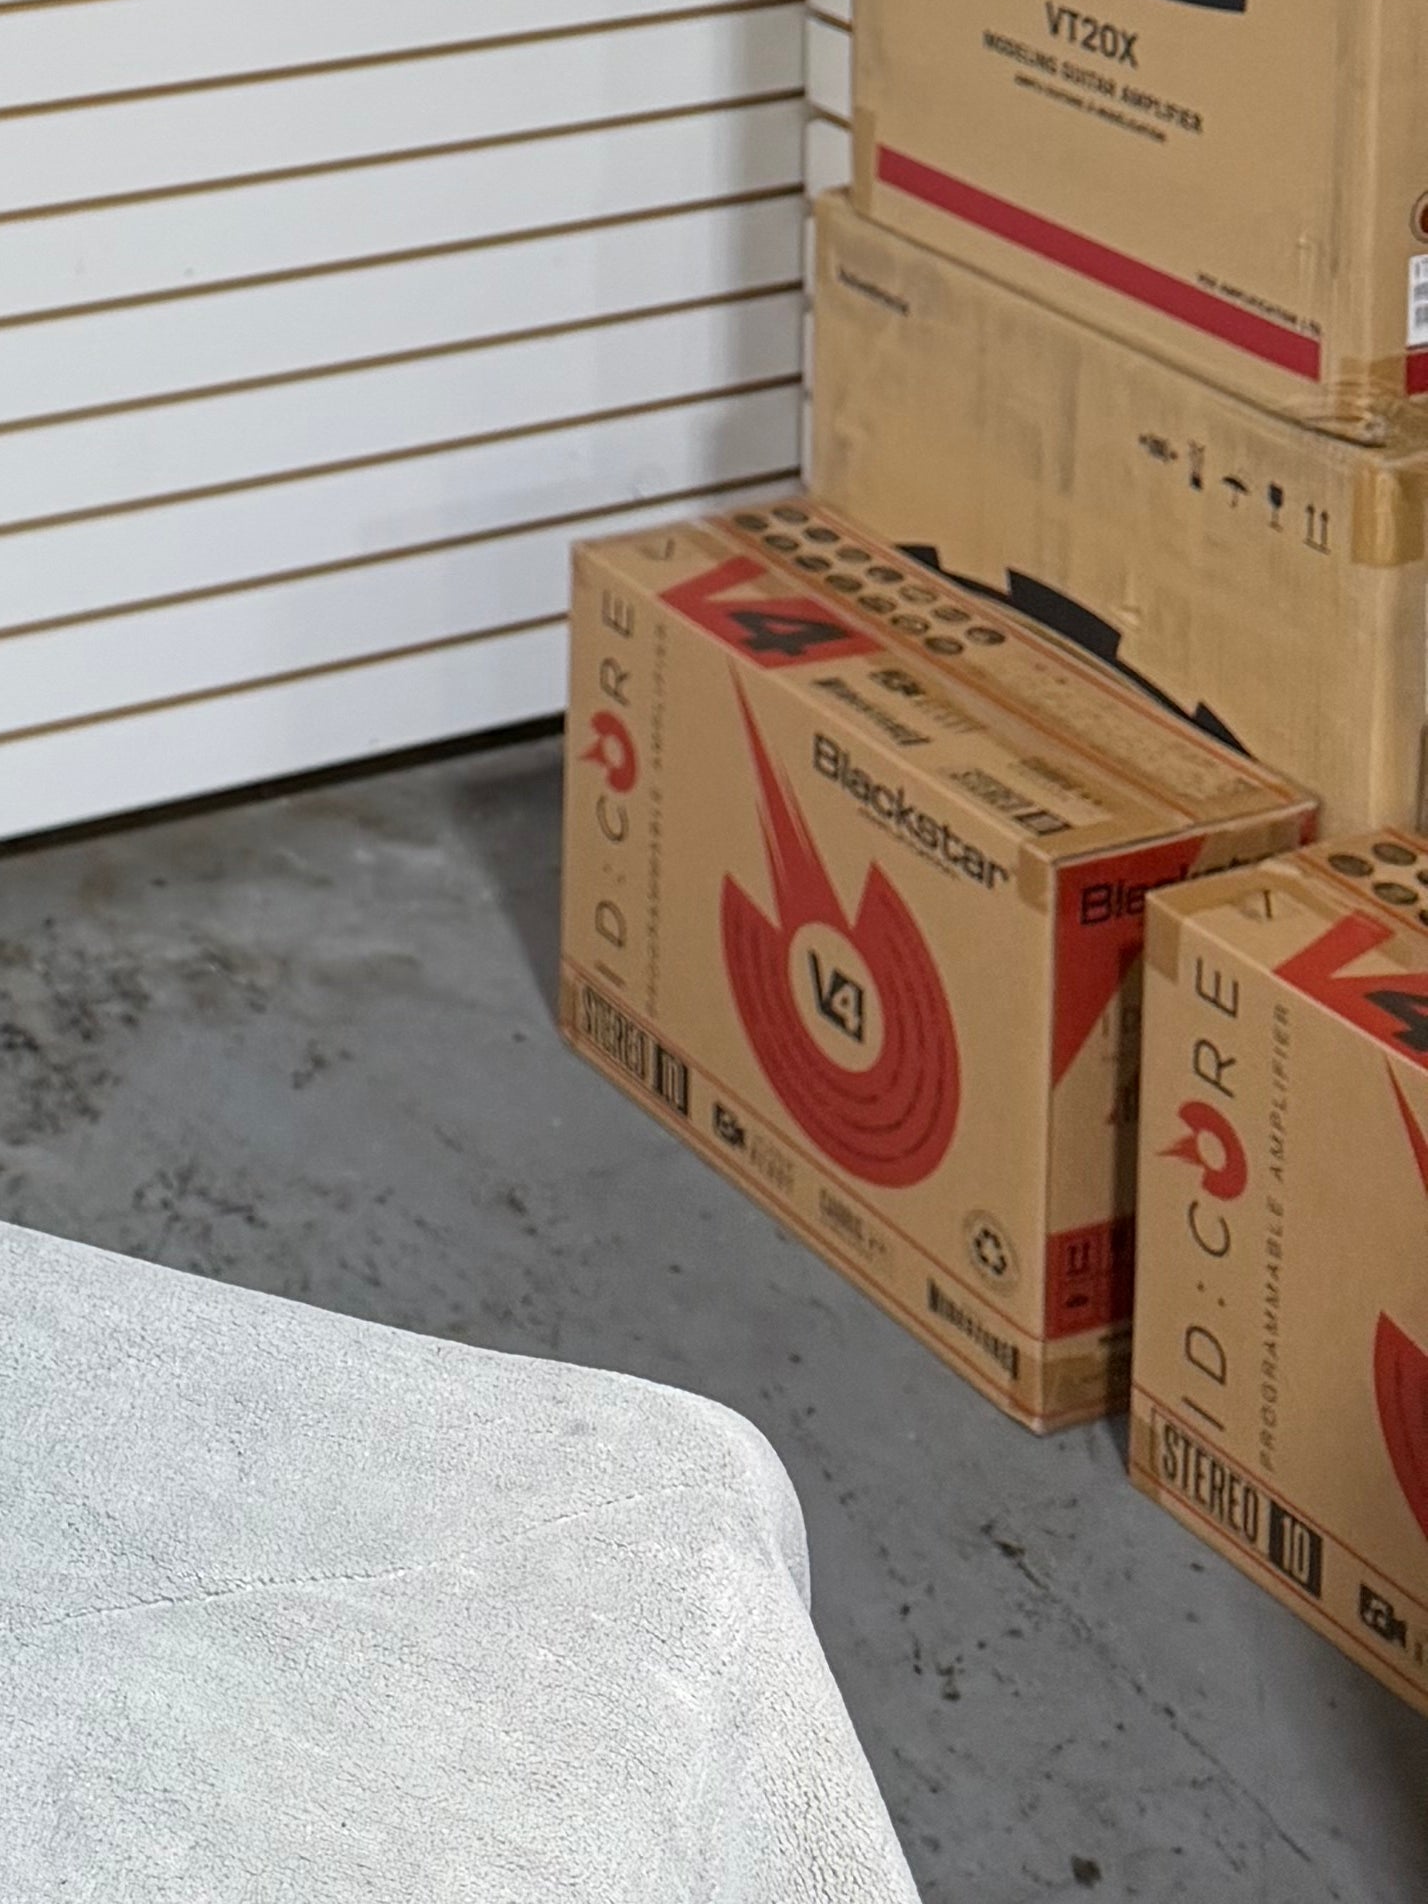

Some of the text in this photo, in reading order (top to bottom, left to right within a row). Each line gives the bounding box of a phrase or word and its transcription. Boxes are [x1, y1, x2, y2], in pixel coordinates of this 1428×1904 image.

[1046, 0, 1139, 68] VT20X
[813, 732, 1011, 893] Blackstar
[1163, 1422, 1260, 1544] STEREO
